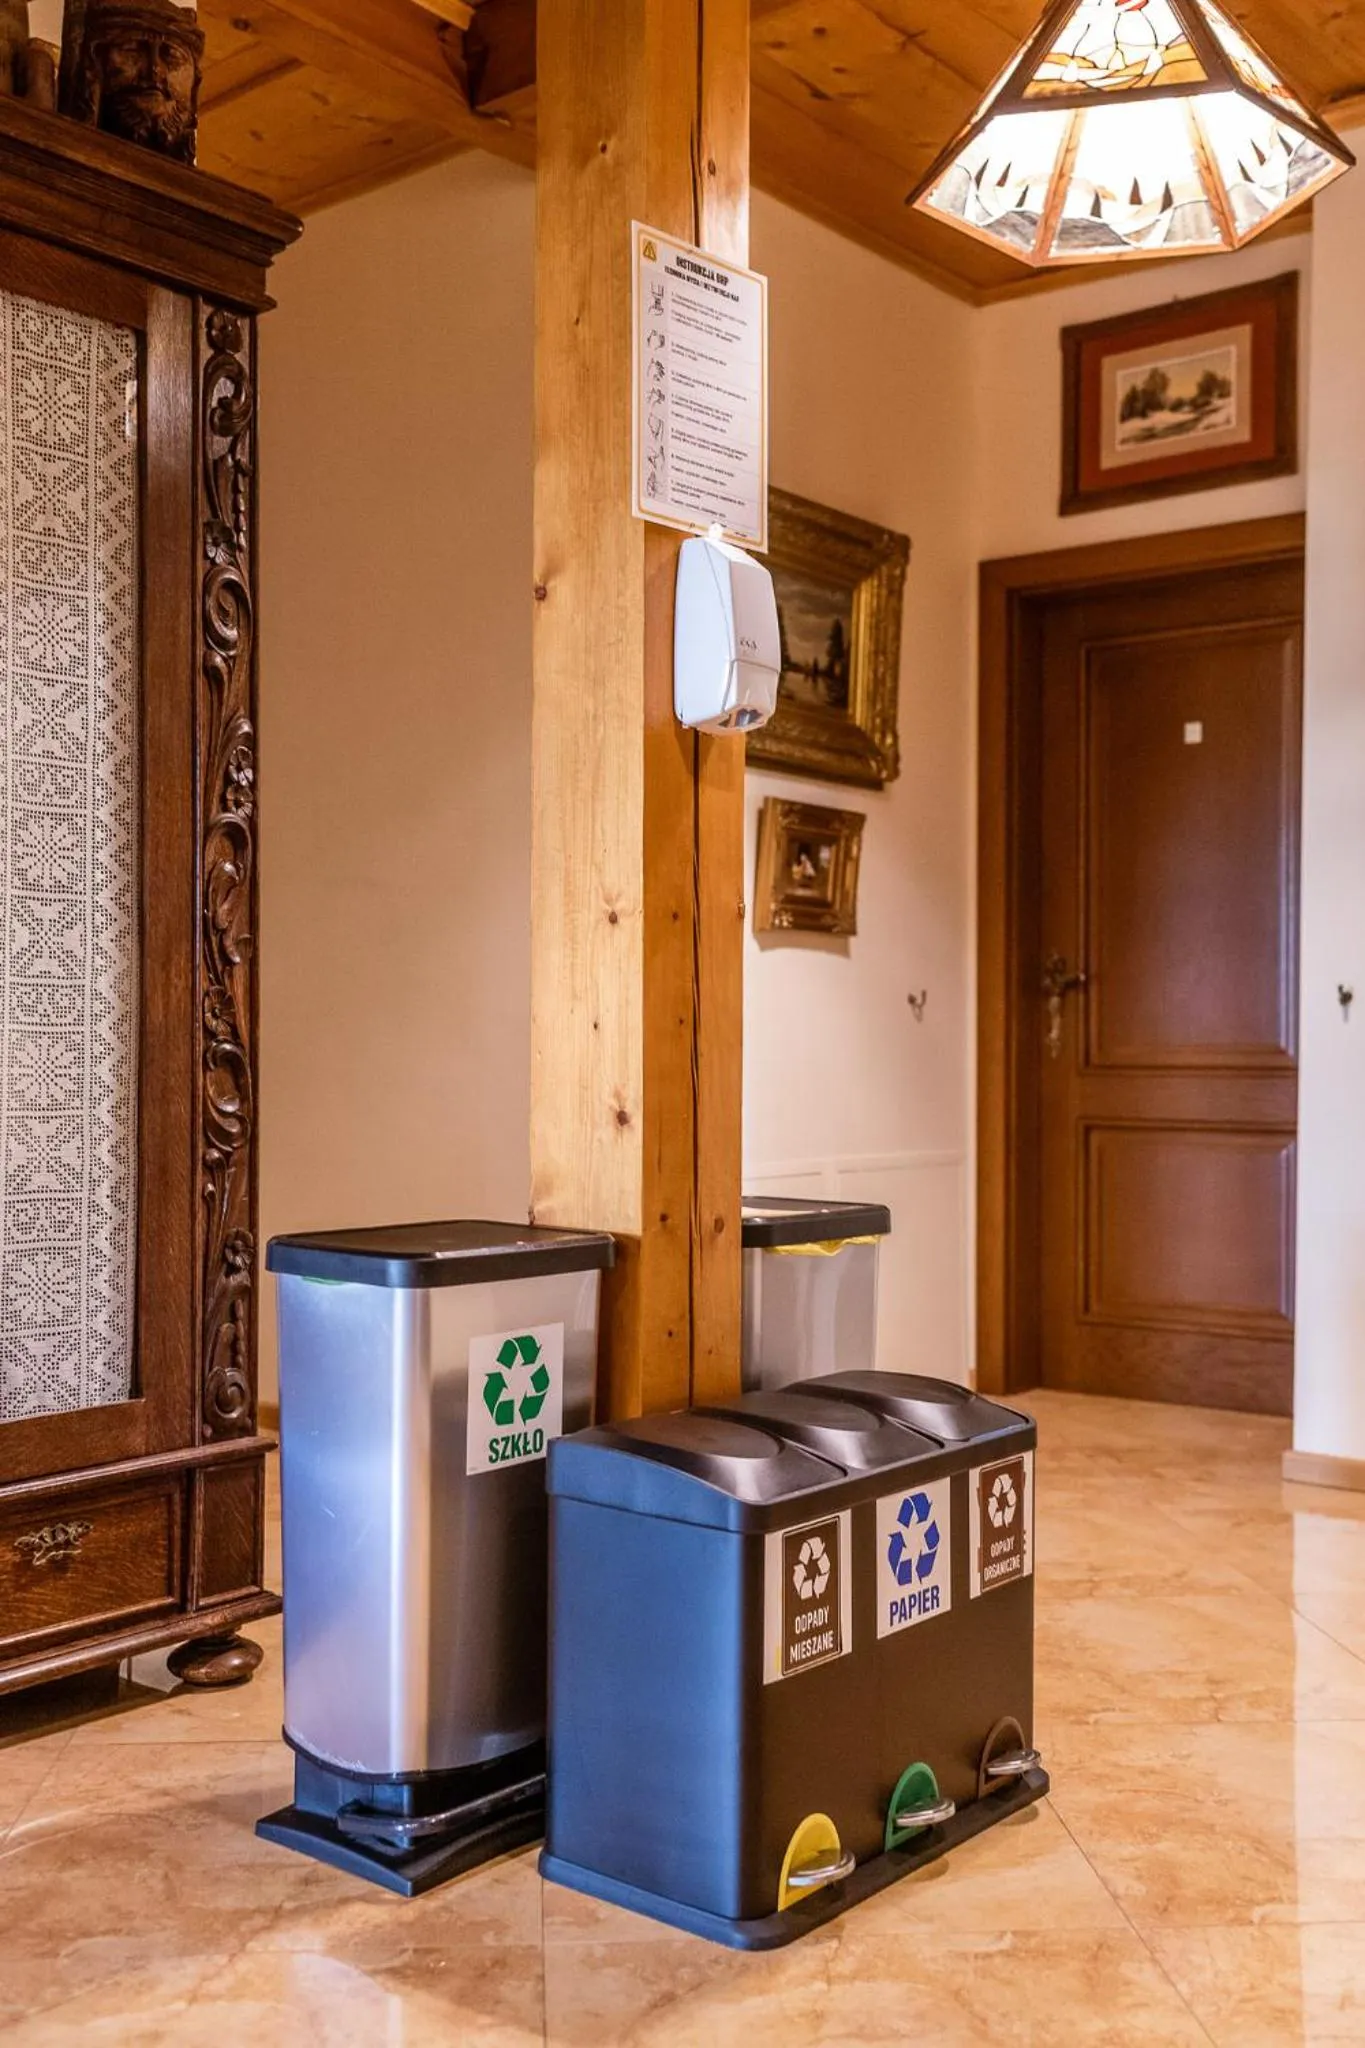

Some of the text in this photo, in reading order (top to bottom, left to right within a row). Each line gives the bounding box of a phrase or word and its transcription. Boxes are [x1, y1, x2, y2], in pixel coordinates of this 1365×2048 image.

[488, 1428, 544, 1464] SZKŁO
[983, 1554, 1021, 1582] ORGANICZNE
[795, 1606, 830, 1634] ODPADY
[889, 1585, 940, 1627] PAPIER
[790, 1631, 834, 1664] MIESZANE
